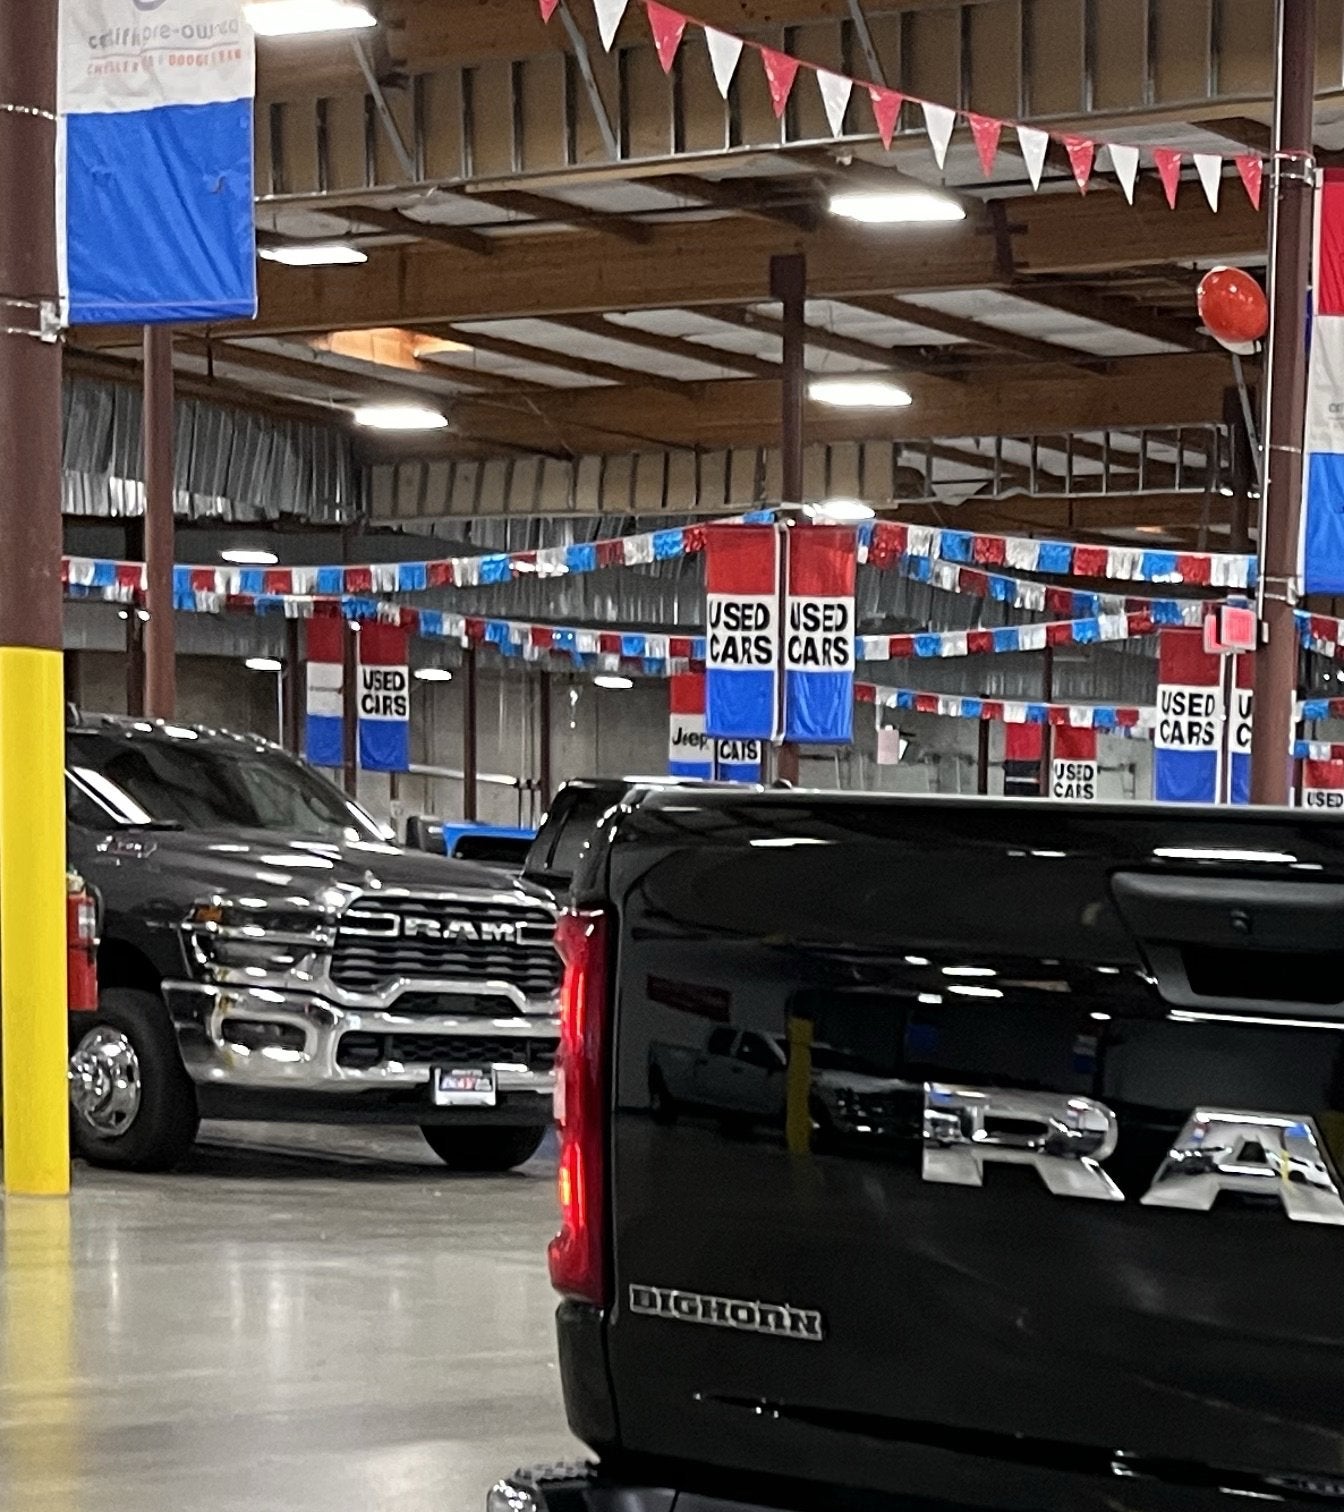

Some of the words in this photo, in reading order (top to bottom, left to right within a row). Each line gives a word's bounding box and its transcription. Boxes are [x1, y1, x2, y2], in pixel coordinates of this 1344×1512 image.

[709, 602, 770, 631] USED
[790, 602, 848, 632] USED
[710, 634, 772, 664] CARS
[788, 635, 849, 666] CARS
[363, 668, 405, 691] USED
[1162, 691, 1215, 717] USED
[1160, 720, 1215, 746] CARS
[1307, 791, 1344, 807] USED
[404, 916, 515, 942] RAM
